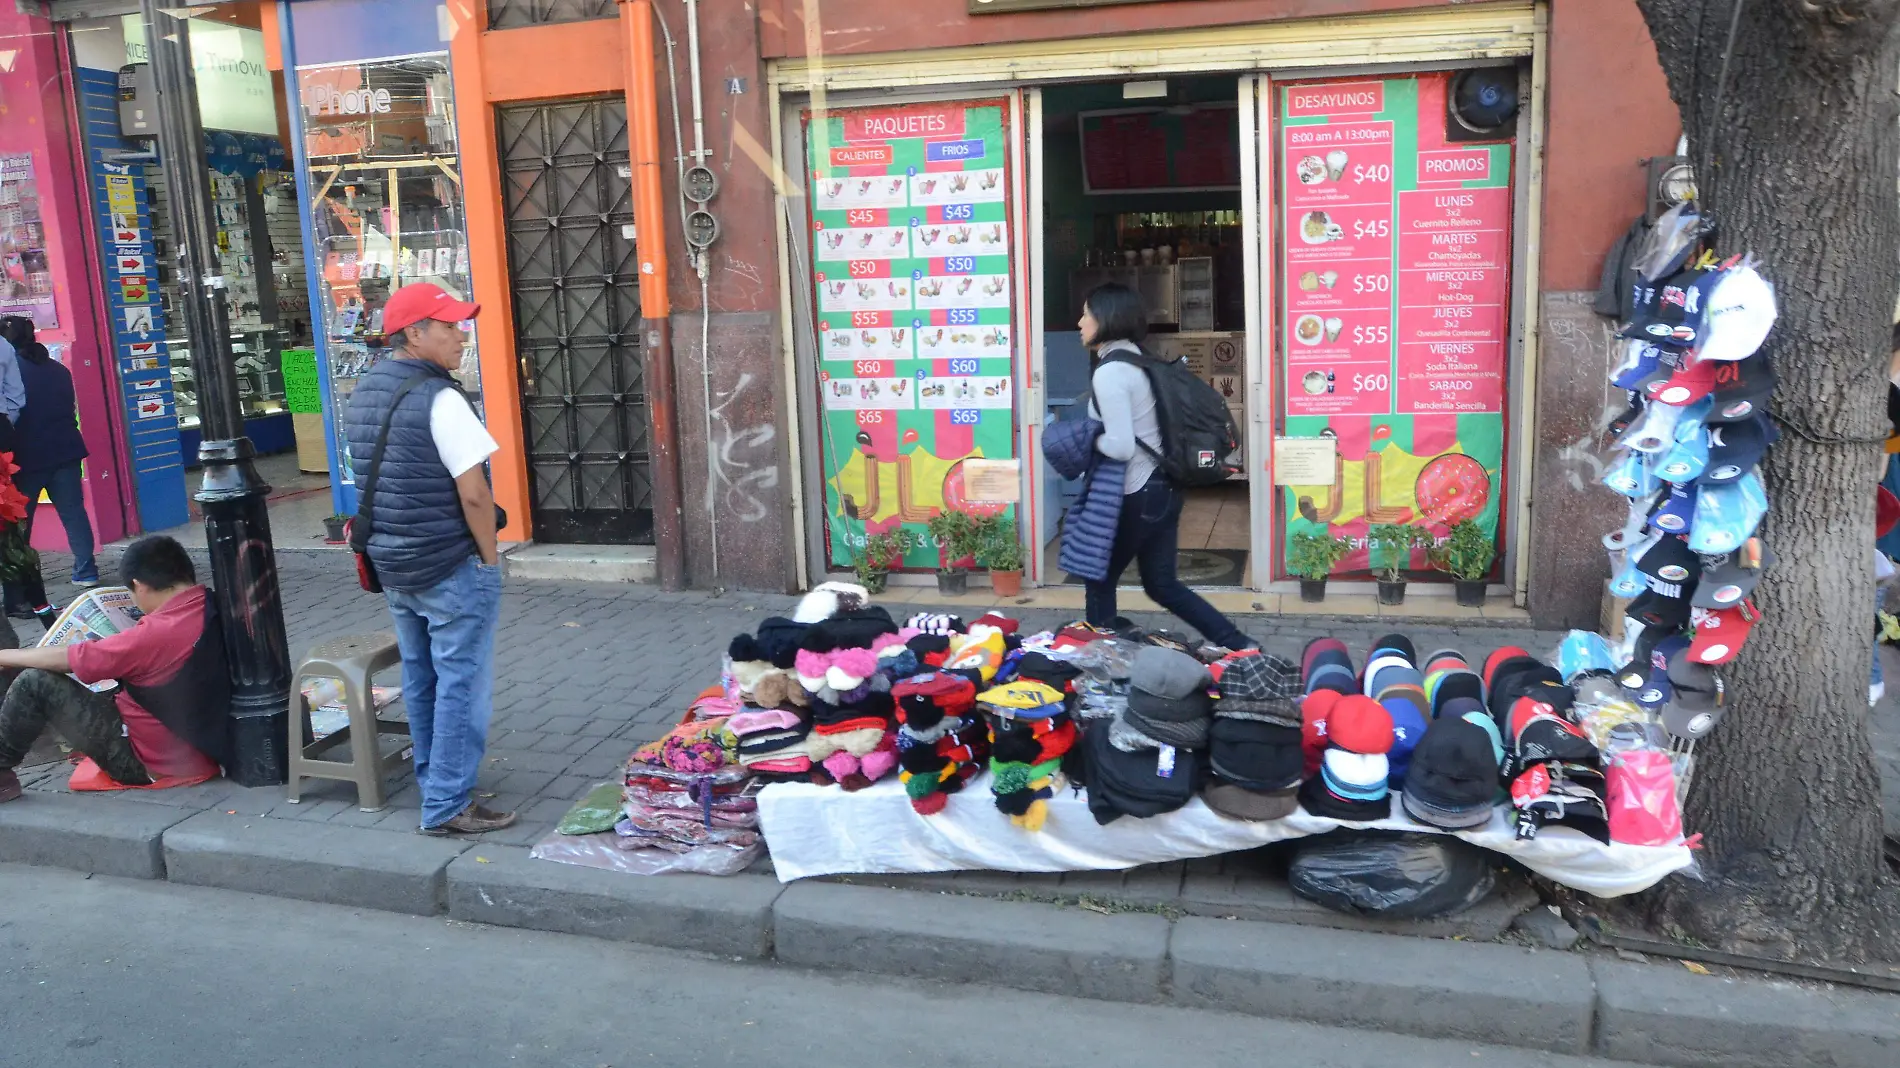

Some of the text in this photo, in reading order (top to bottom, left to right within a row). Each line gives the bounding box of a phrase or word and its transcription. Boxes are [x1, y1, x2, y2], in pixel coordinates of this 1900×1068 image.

[729, 77, 743, 96] A
[1294, 91, 1376, 110] DESAYUNOS
[864, 114, 946, 135] PAQUETES
[1291, 132, 1314, 143] 8:00
[1315, 133, 1332, 142] am
[1334, 130, 1342, 140] A
[836, 149, 886, 161] CALIENTES
[941, 144, 970, 156] FRIOS
[1425, 157, 1486, 174] PROMOS
[1353, 164, 1391, 184] $40
[1434, 194, 1475, 208] LUNES
[849, 209, 874, 224] $45
[945, 204, 971, 220] $45
[1445, 208, 1461, 217] 3x2
[1353, 218, 1390, 241] $45
[1412, 217, 1482, 229] Cuernito Relleno
[1431, 233, 1478, 245] MARTES
[850, 260, 876, 275] $50
[947, 256, 973, 272] $50
[1426, 270, 1485, 282] MIERCOLES
[1353, 273, 1390, 295] $50
[1437, 292, 1474, 303] Hot-Dog
[854, 310, 879, 326] $55
[950, 308, 976, 324] $55
[1432, 307, 1473, 318] JUEVES
[1443, 319, 1459, 328] 3x2
[1353, 324, 1389, 347] $55
[1429, 343, 1475, 354] VIERNES
[856, 359, 881, 375] $60
[951, 358, 977, 374] $60
[1425, 362, 1478, 371] Soda Italiana
[1352, 372, 1389, 393] $60
[1429, 380, 1473, 391] SABADO
[1441, 391, 1456, 400] 3x2
[1413, 400, 1487, 410] Banderilla Sencilla
[858, 409, 883, 425] $65
[953, 409, 979, 425] $65
[916, 534, 928, 548] &
